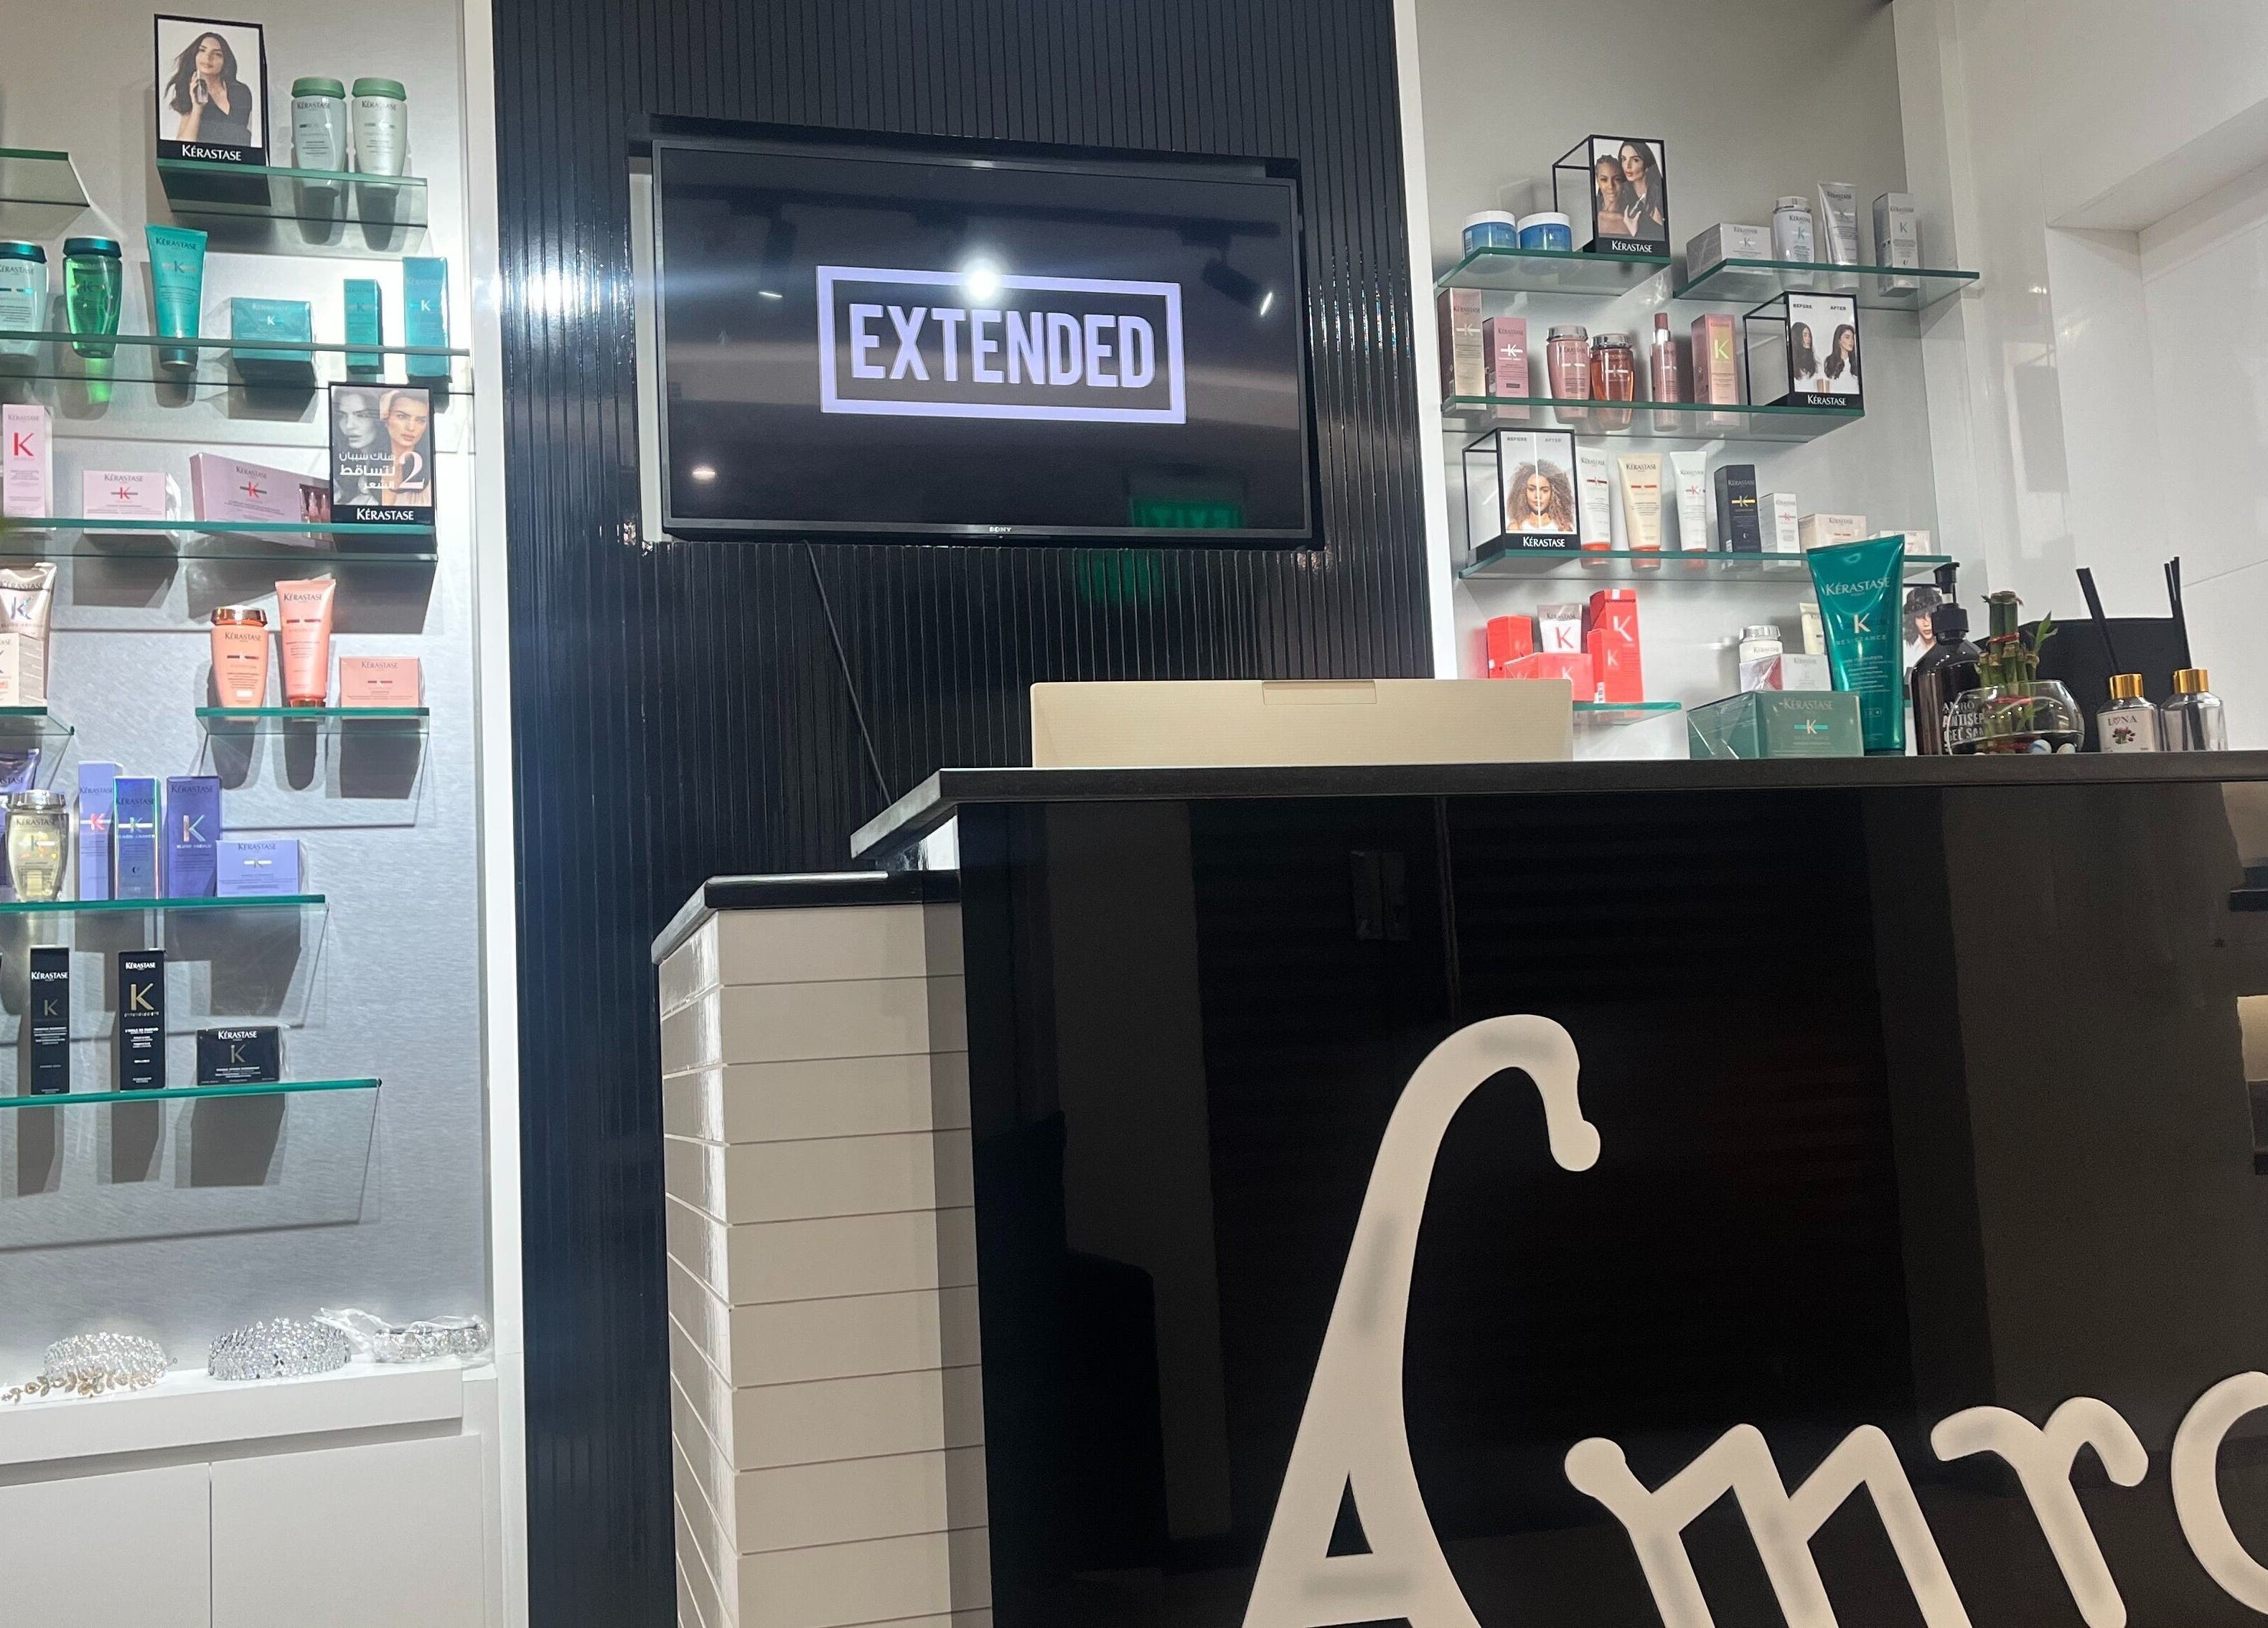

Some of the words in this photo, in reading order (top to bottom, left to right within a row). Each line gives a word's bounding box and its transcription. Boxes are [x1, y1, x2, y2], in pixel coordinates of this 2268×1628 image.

[361, 100, 396, 111] KÉRAASE
[182, 144, 242, 162] KÉRASTASE
[1900, 221, 1908, 233] K
[1611, 240, 1653, 253] KÉRASTASE
[0, 264, 34, 275] ÉRASTASE
[420, 299, 431, 312] K
[267, 315, 276, 325] K
[849, 302, 1156, 389] EXTENDED
[1507, 343, 1517, 357] K
[1714, 339, 1729, 359] K
[1807, 394, 1847, 406] KÉRASTASE
[14, 432, 34, 457] K
[104, 473, 143, 482] KÉRASTASE
[339, 464, 395, 477] لتساقط
[398, 451, 425, 490] 2
[119, 486, 130, 500] K
[248, 482, 260, 498] K
[1739, 495, 1748, 507] K
[356, 507, 414, 521] KÉRASTASE
[1522, 536, 1565, 548] KÉRASTASE
[1825, 577, 1890, 596] KÉRASTASE
[284, 592, 322, 602] KÉRASTASE
[1613, 615, 1633, 642] K
[1853, 613, 1871, 634] K
[225, 632, 261, 642] KÉRASTASE
[1555, 625, 1574, 649] K
[1607, 649, 1618, 666] K
[1807, 719, 1817, 734] K
[90, 813, 106, 831] K
[183, 815, 206, 842] K
[31, 971, 68, 981] KÉRASTASE
[131, 983, 154, 1011] K
[44, 998, 58, 1016] K
[217, 1030, 258, 1040] KÉRASTASE
[230, 1044, 246, 1063] K
